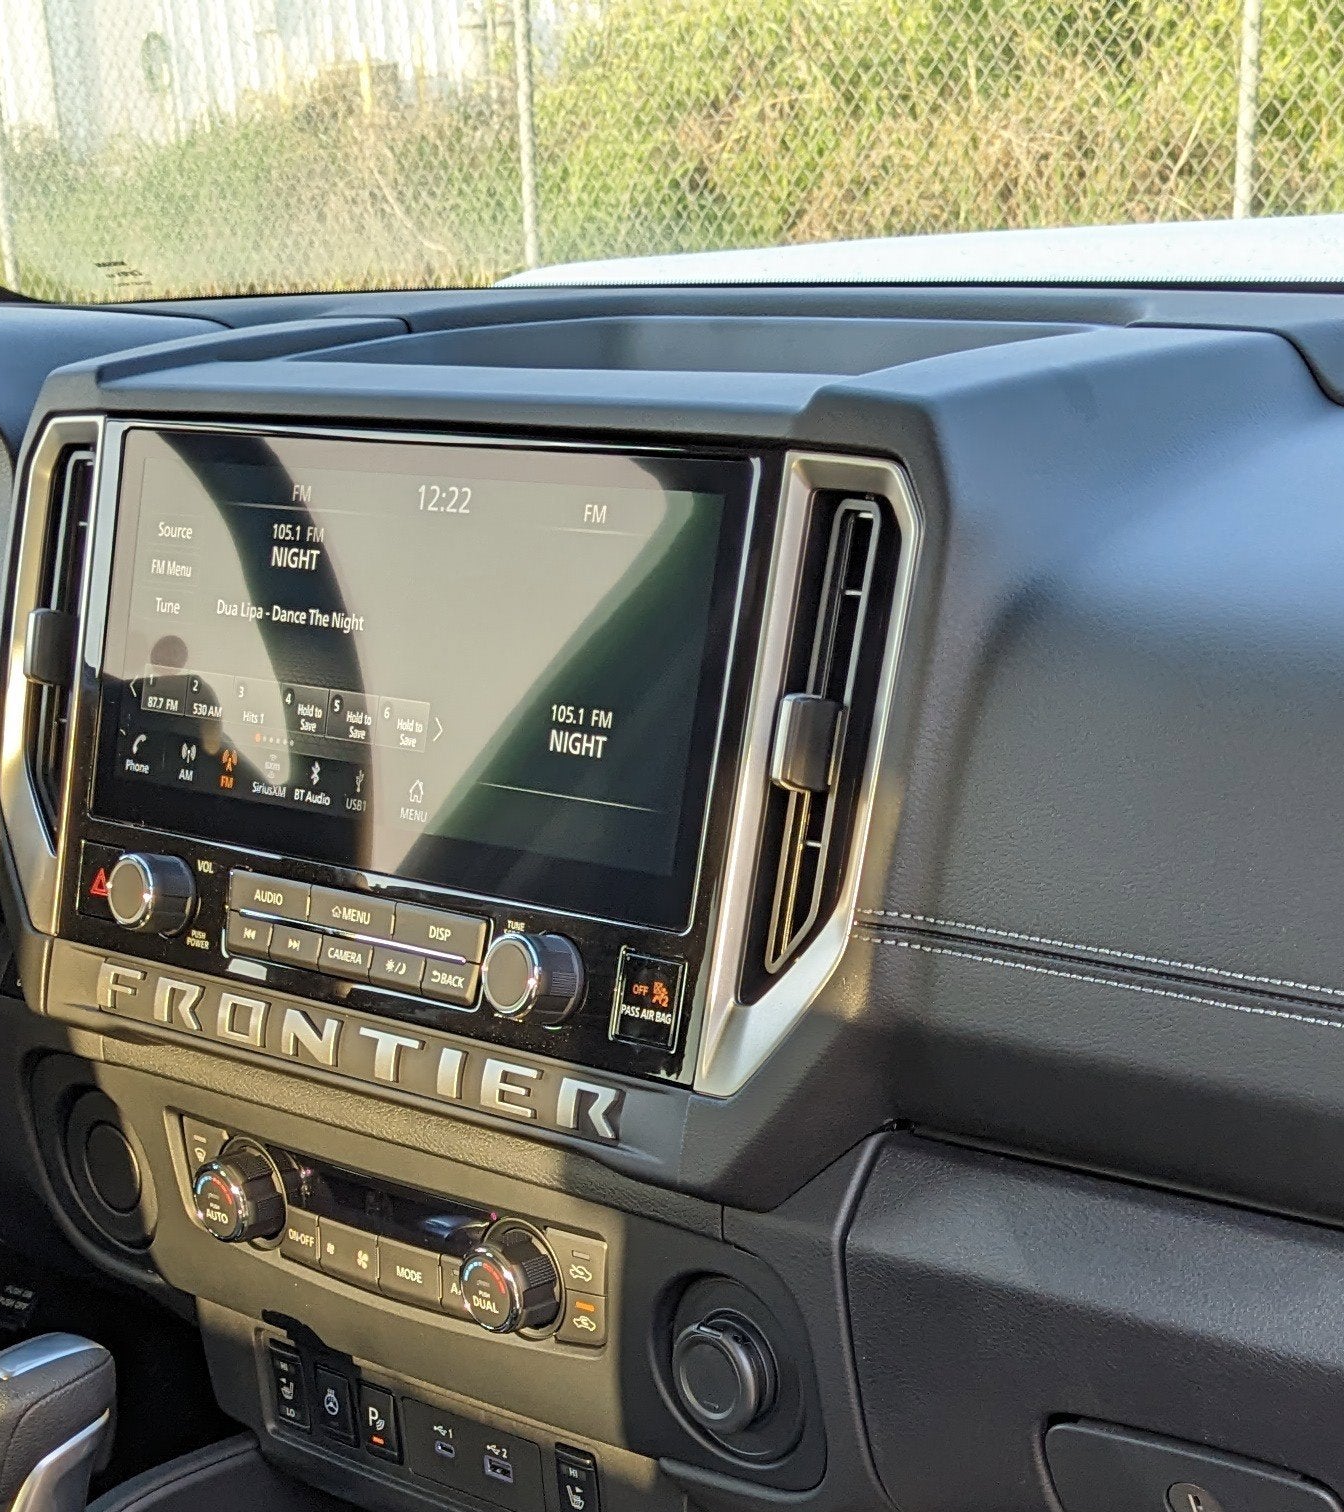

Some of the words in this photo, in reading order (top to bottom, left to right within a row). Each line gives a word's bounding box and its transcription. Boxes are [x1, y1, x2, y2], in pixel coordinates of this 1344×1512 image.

[292, 484, 311, 502] FM
[418, 484, 472, 514] 12:22
[583, 504, 607, 524] FM
[158, 522, 193, 539] Source
[272, 523, 300, 541] 105.1
[306, 526, 324, 542] FM
[271, 546, 320, 571] NIGHT
[151, 559, 164, 575] FM
[167, 560, 192, 578] Menu
[155, 597, 180, 615] Tune
[217, 599, 238, 617] Dua
[241, 602, 263, 621] Lipa
[272, 605, 307, 624] Dance
[308, 609, 329, 627] The
[331, 612, 364, 634] Night
[166, 699, 179, 712] FM
[192, 703, 207, 716] 530
[207, 706, 222, 718] AM
[297, 703, 313, 717] Hold
[314, 707, 323, 719] to
[242, 710, 258, 723] Hits
[300, 718, 317, 732] Save
[346, 710, 363, 725] Hold
[364, 714, 372, 726] to
[551, 704, 584, 725] 105.1
[591, 709, 613, 729] FM
[349, 725, 366, 739] Save
[396, 718, 414, 732] Hold
[415, 721, 423, 733] to
[399, 734, 417, 748] Save
[549, 729, 607, 758] NIGHT
[125, 759, 150, 774] Phone
[178, 769, 193, 782] AM
[220, 775, 234, 789] FM
[252, 782, 286, 798] SiriusXM
[293, 789, 305, 801] BT
[306, 791, 331, 806] Audio
[400, 808, 428, 823] MENU
[197, 859, 214, 874] VOL
[254, 889, 283, 906] AUDIO
[342, 906, 371, 925] MENU
[429, 925, 451, 942] DISP
[327, 947, 362, 965] CAMERA
[441, 974, 465, 989] BACK
[632, 984, 649, 996] OFF
[621, 1004, 641, 1017] PASS
[640, 1009, 655, 1021] AIR
[655, 1011, 672, 1025] BAG
[97, 961, 627, 1140] FRONTIER
[206, 1208, 228, 1224] AUTO
[396, 1266, 423, 1284] MODE
[472, 1295, 499, 1314] DUAL
